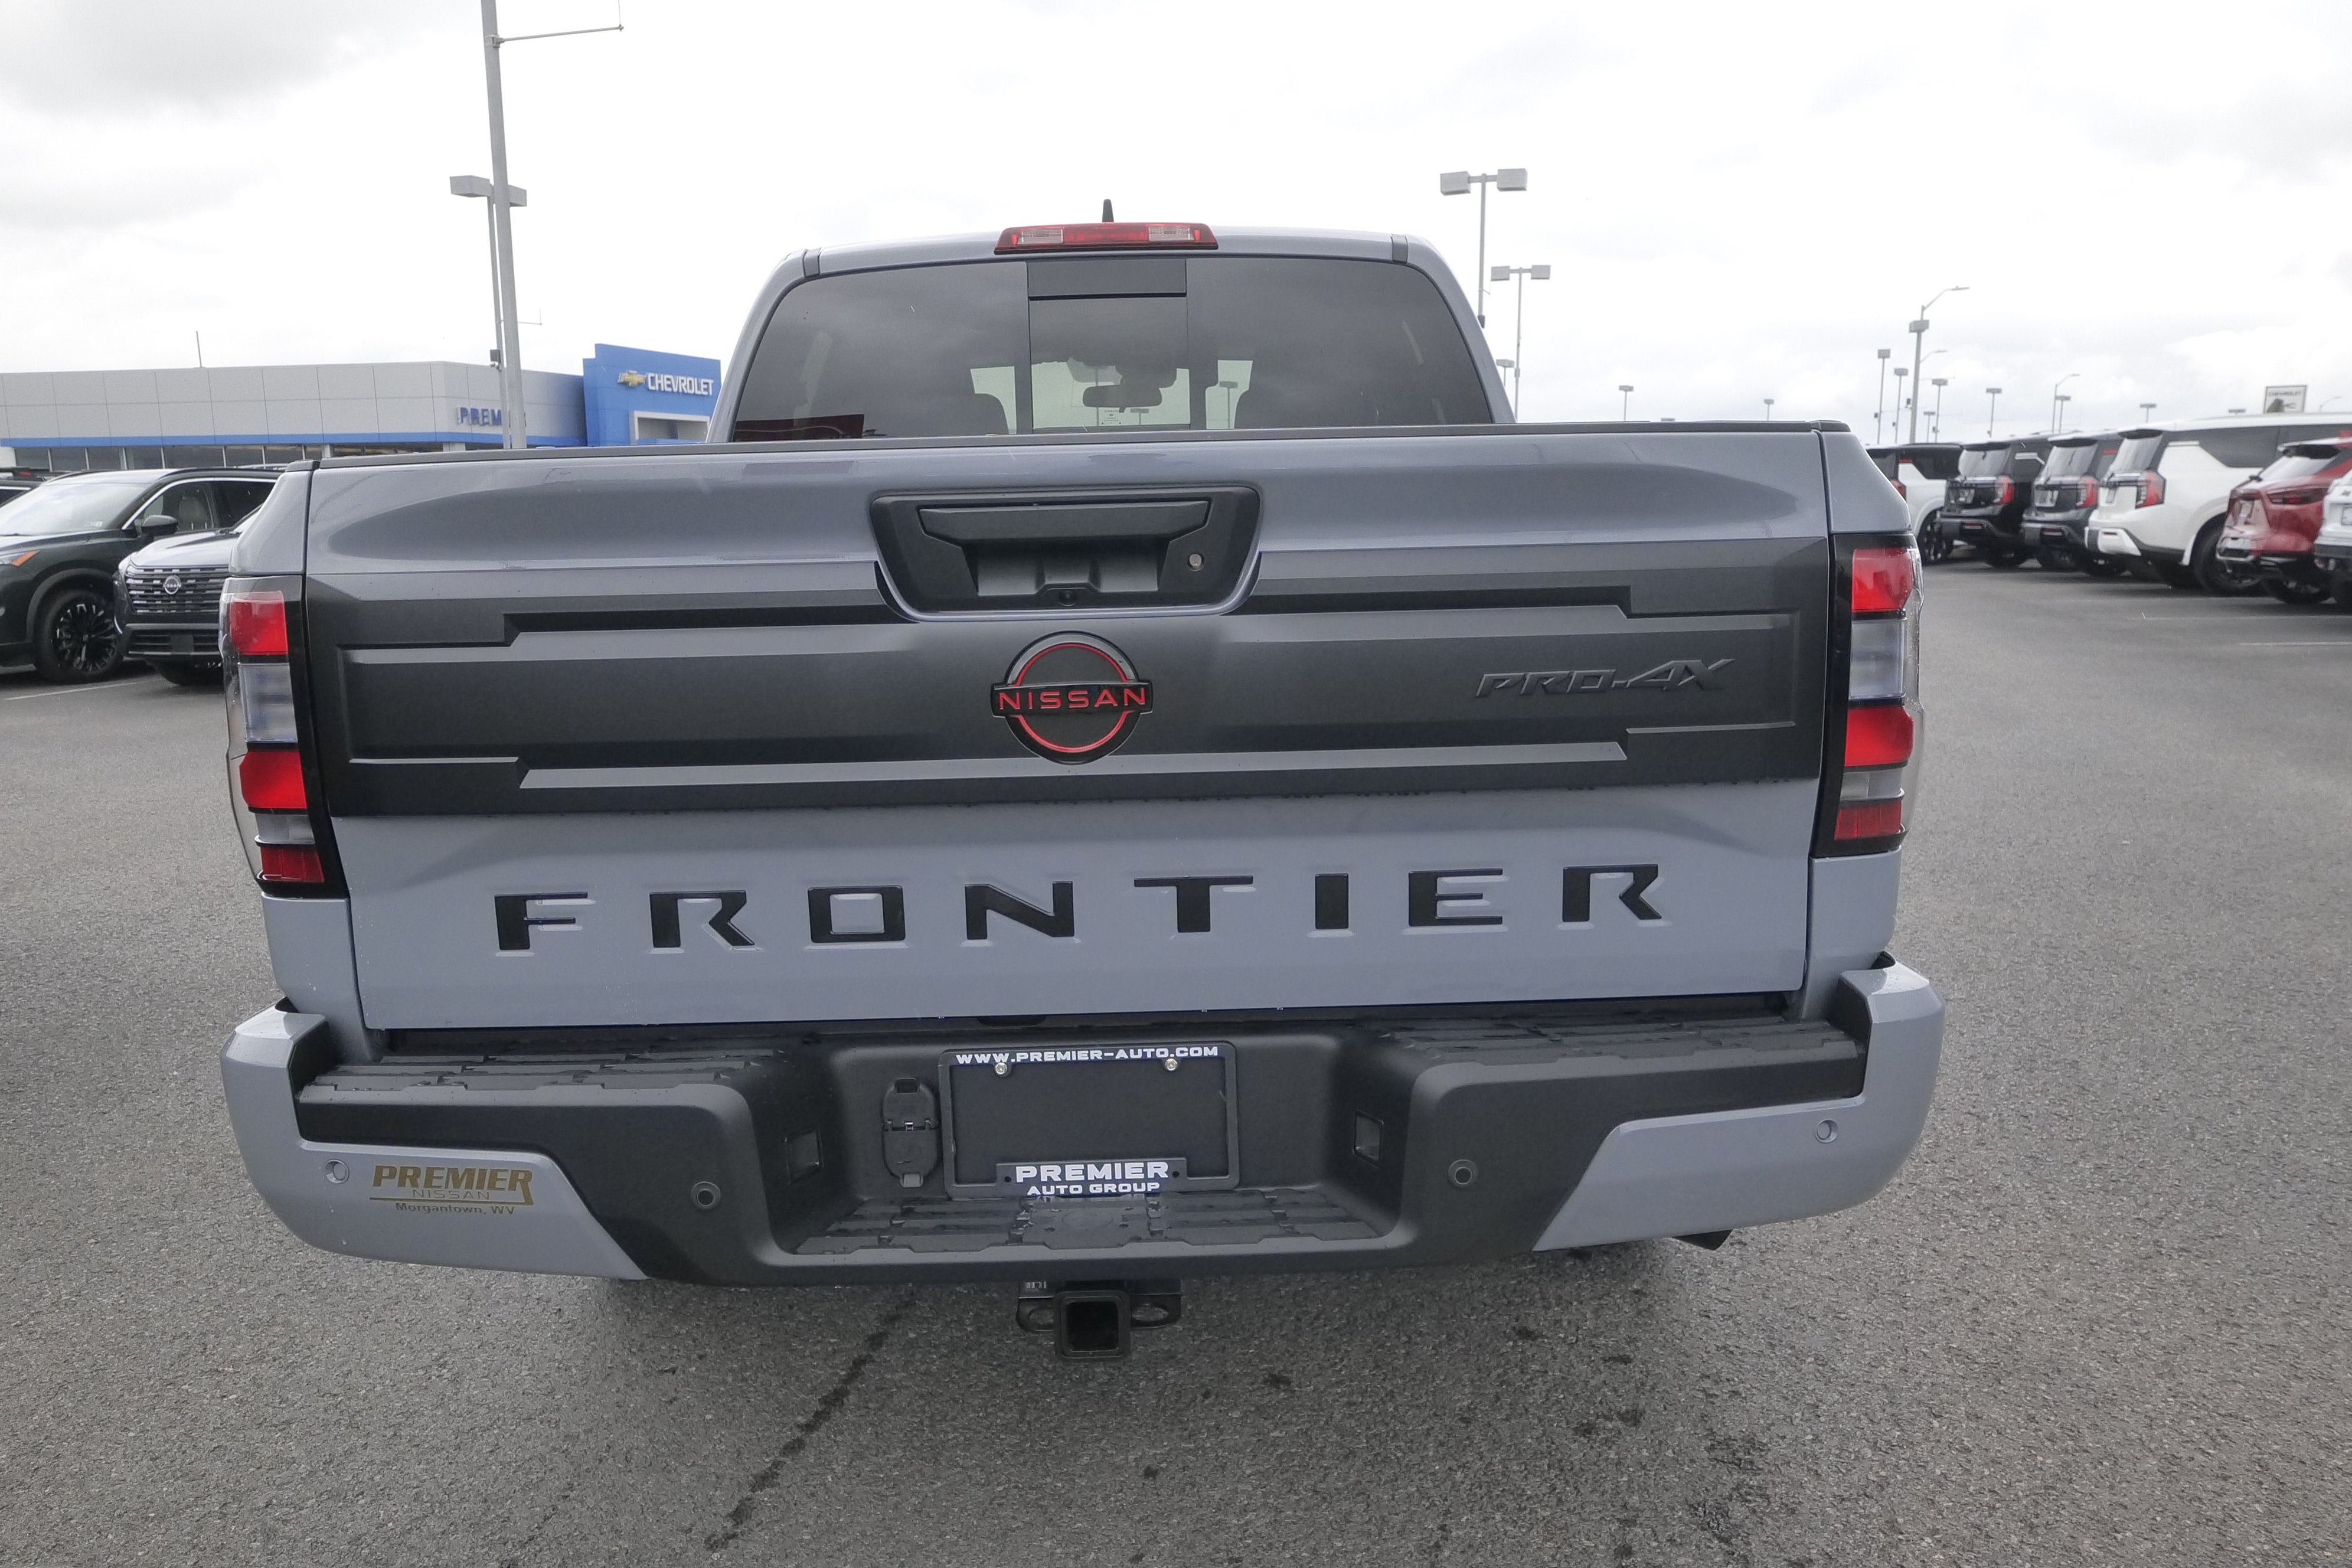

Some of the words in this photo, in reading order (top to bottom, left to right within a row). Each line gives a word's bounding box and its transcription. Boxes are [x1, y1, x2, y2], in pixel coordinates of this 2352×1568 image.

[648, 373, 714, 396] CHEVROLET
[459, 407, 511, 426] PREM
[1476, 658, 1736, 697] PRO-4X
[999, 687, 1145, 710] NISSAN
[494, 863, 1668, 952] FRONTIER
[956, 1046, 1219, 1064] WWW.PREMIER-AUTO.COM
[1015, 1161, 1169, 1183] PREMIER
[372, 1165, 534, 1206] PREMIER
[413, 1188, 489, 1200] NISSAN
[1027, 1185, 1083, 1196] AUTO
[1089, 1182, 1161, 1194] GROUP
[491, 1206, 515, 1215] WV
